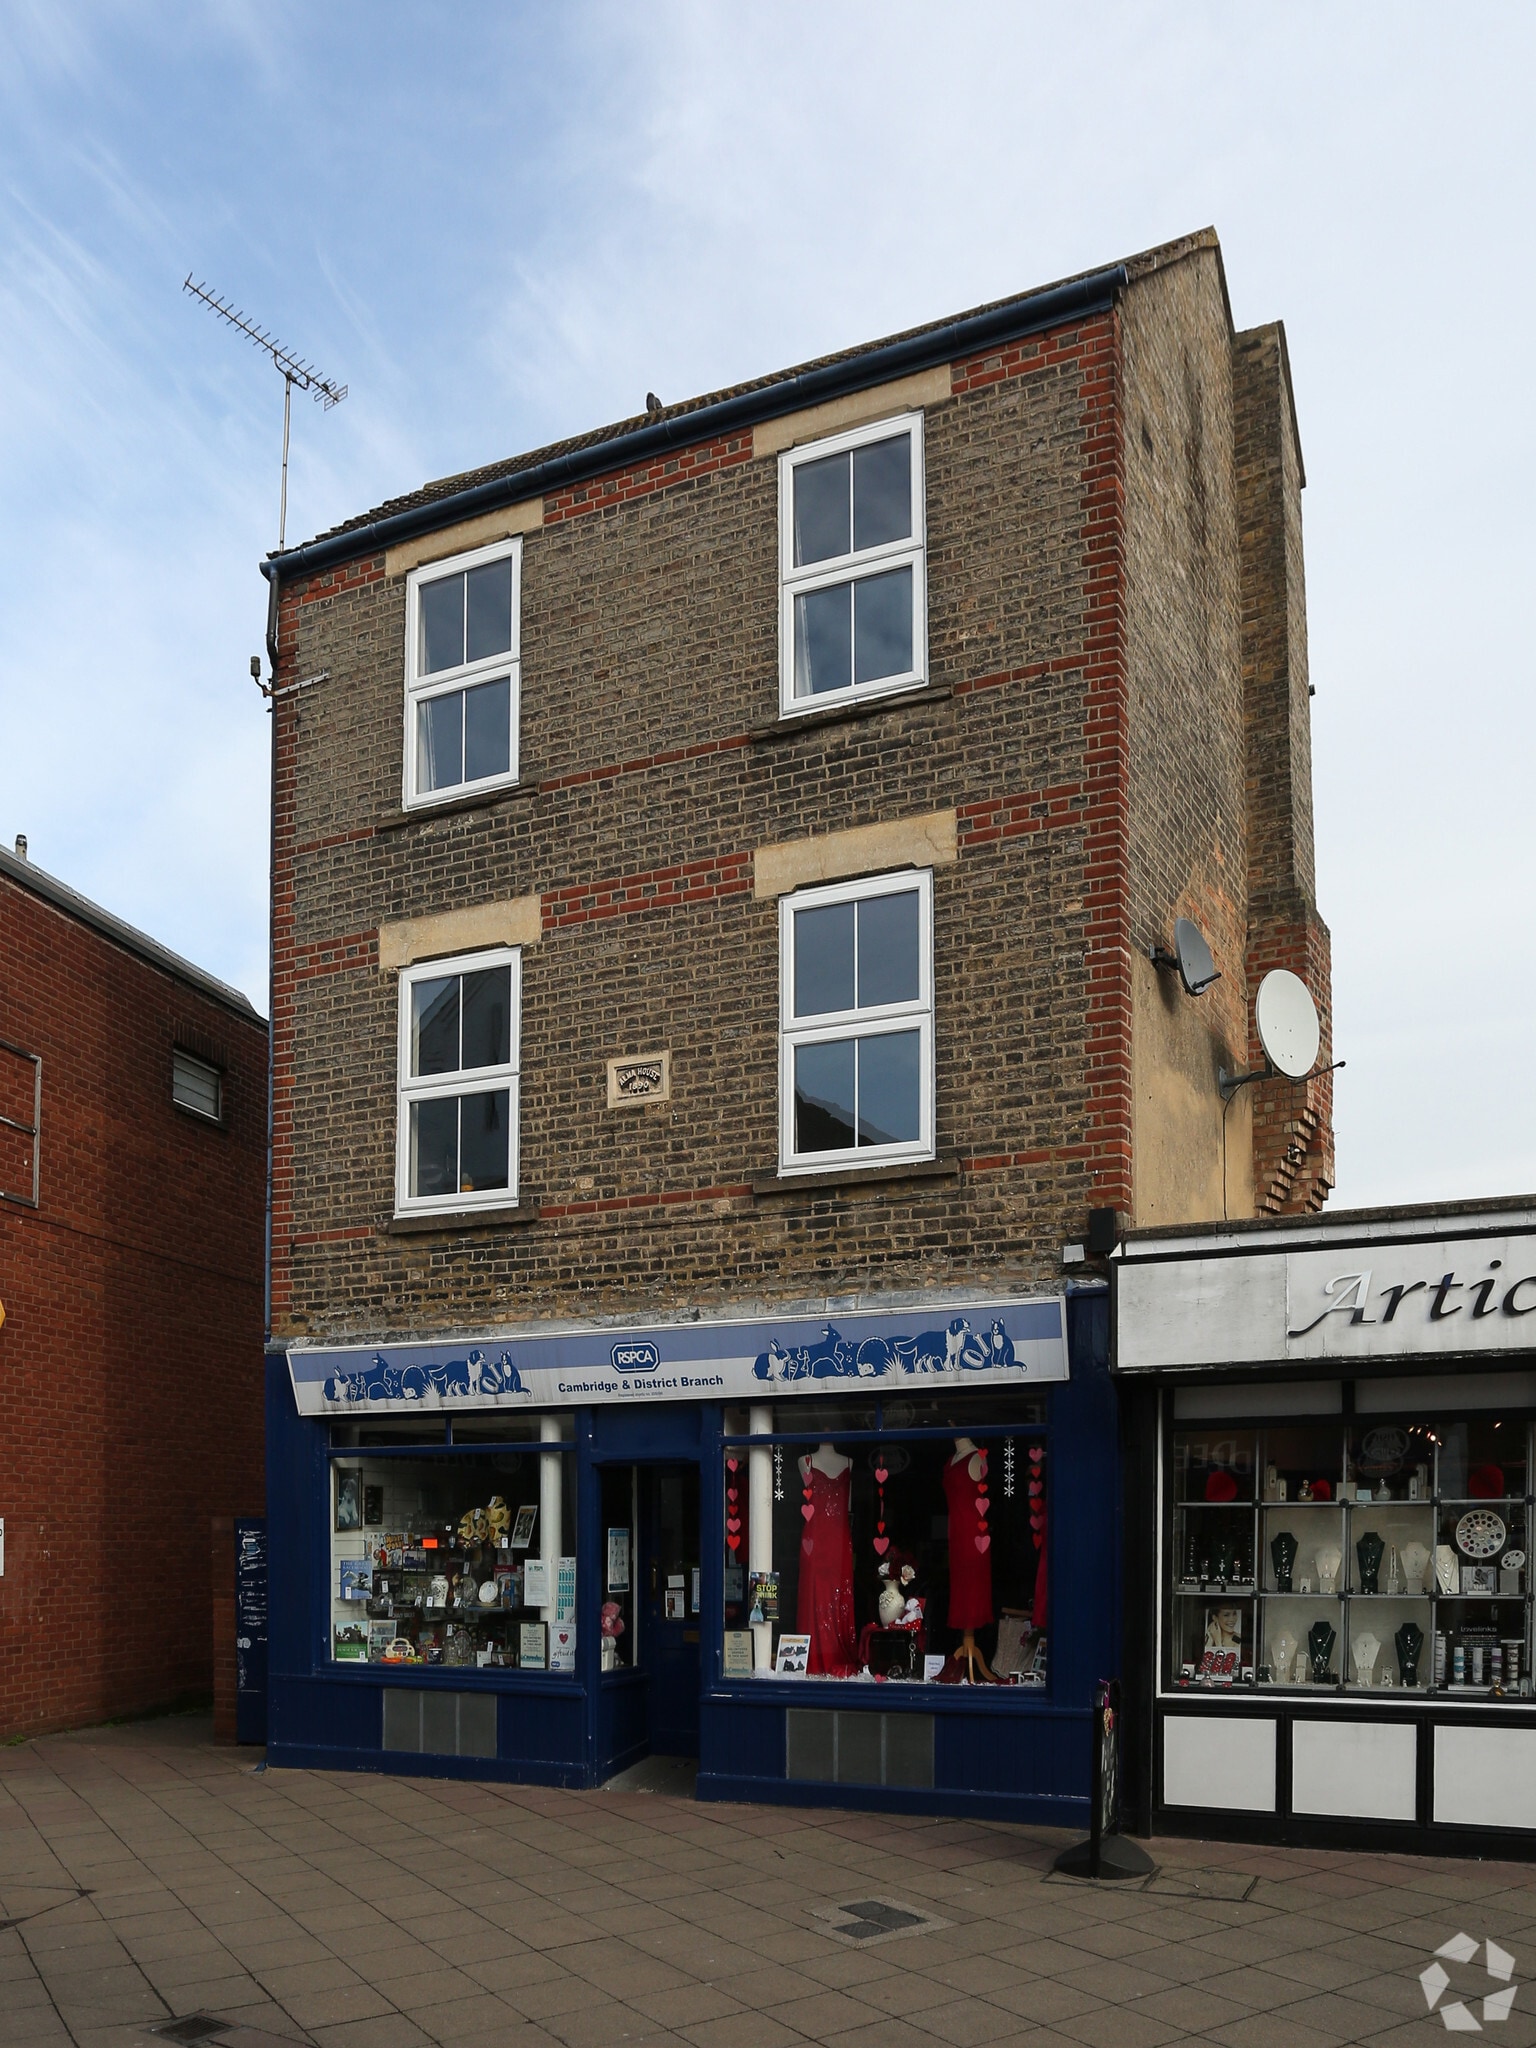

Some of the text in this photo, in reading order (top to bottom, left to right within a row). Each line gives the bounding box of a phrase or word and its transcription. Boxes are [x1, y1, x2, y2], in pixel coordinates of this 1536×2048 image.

[619, 1067, 660, 1086] ALMA HOUSE
[617, 1349, 654, 1365] RSPCA
[558, 1375, 724, 1393] Cambridge & District Branch
[756, 1584, 778, 1592] STOP
